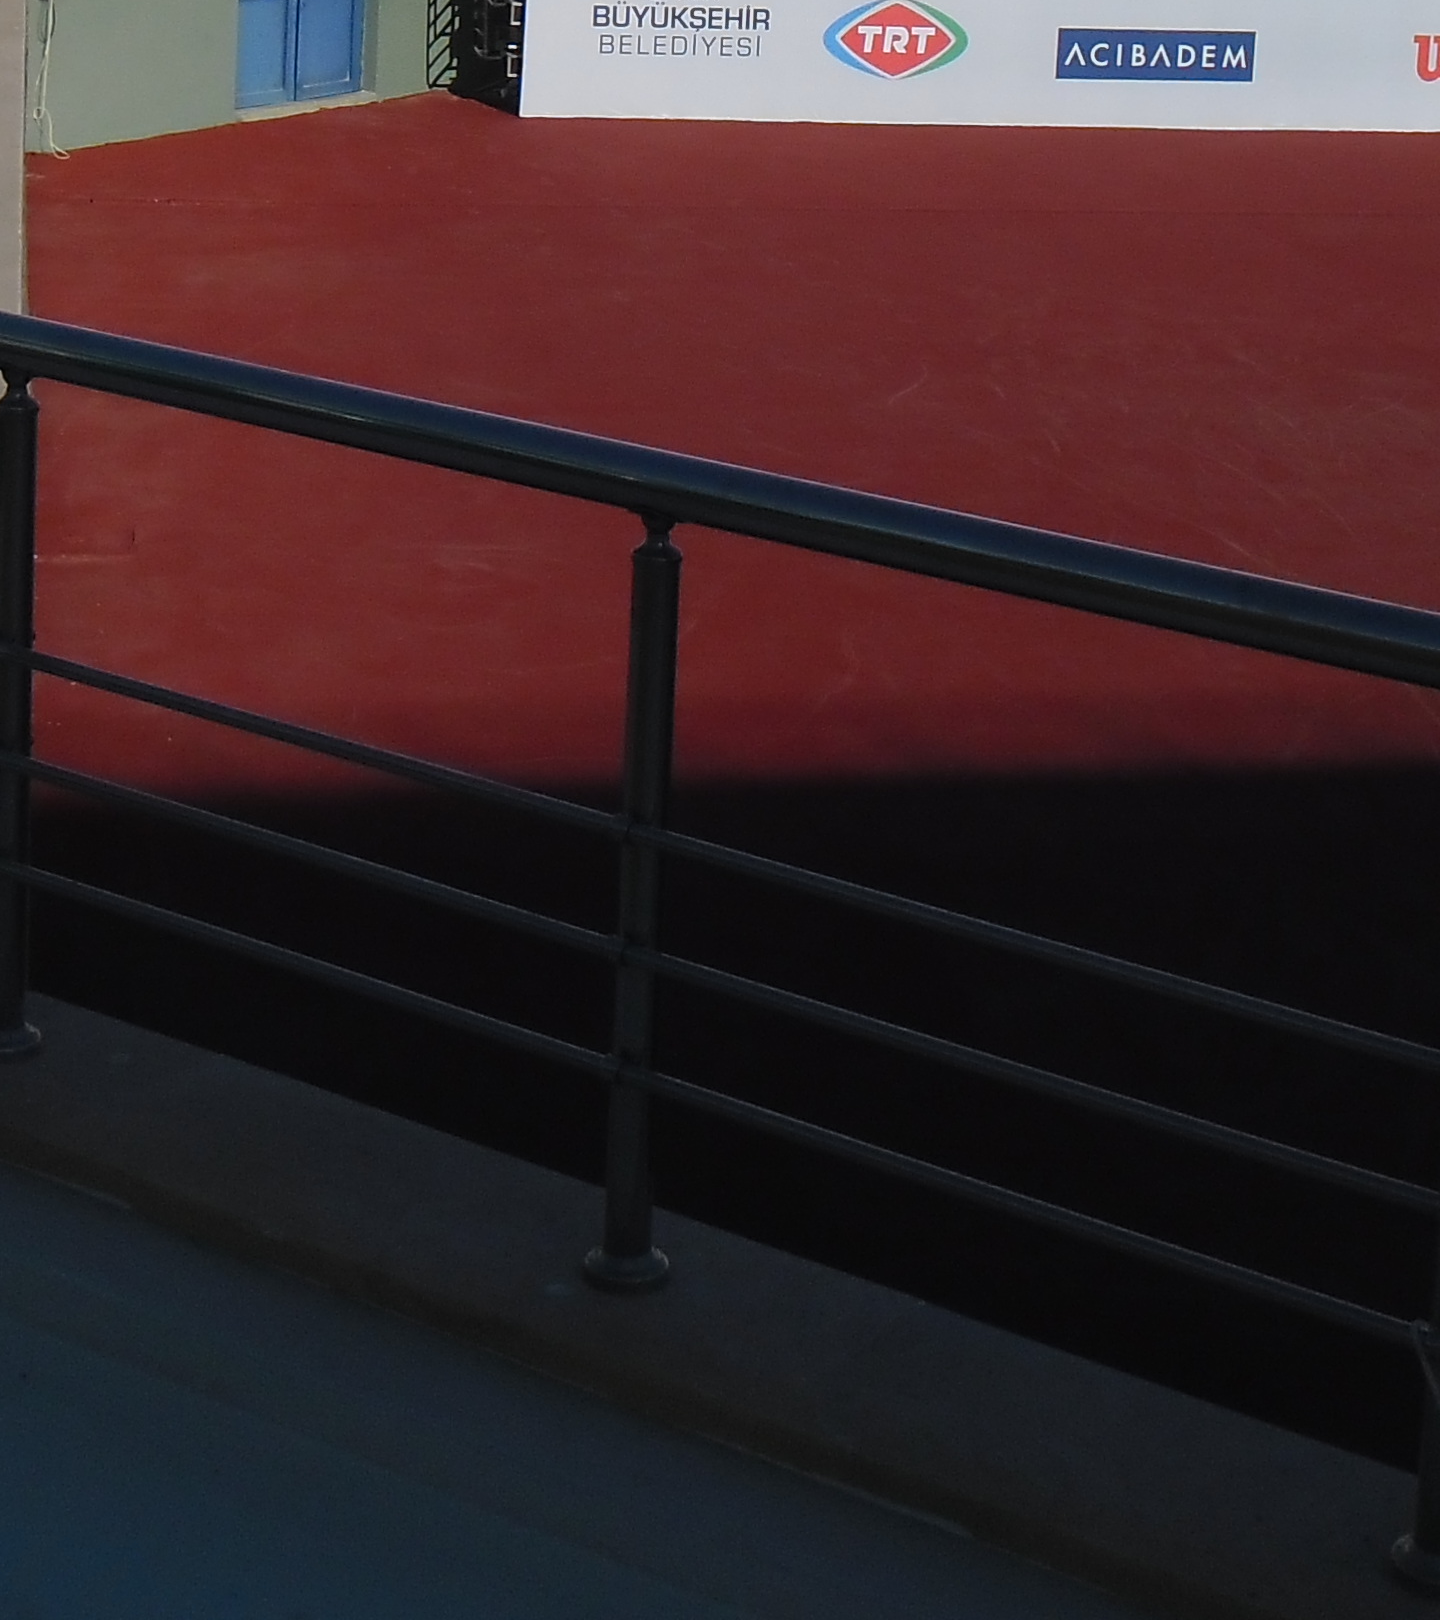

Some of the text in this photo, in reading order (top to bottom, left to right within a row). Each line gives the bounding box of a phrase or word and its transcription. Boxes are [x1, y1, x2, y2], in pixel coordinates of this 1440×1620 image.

[592, 0, 771, 33] BÜYÜKŞEHİR
[599, 33, 762, 57] BELEDİYESİ
[857, 26, 936, 55] TRT
[1063, 42, 1248, 69] ACIBADEM
